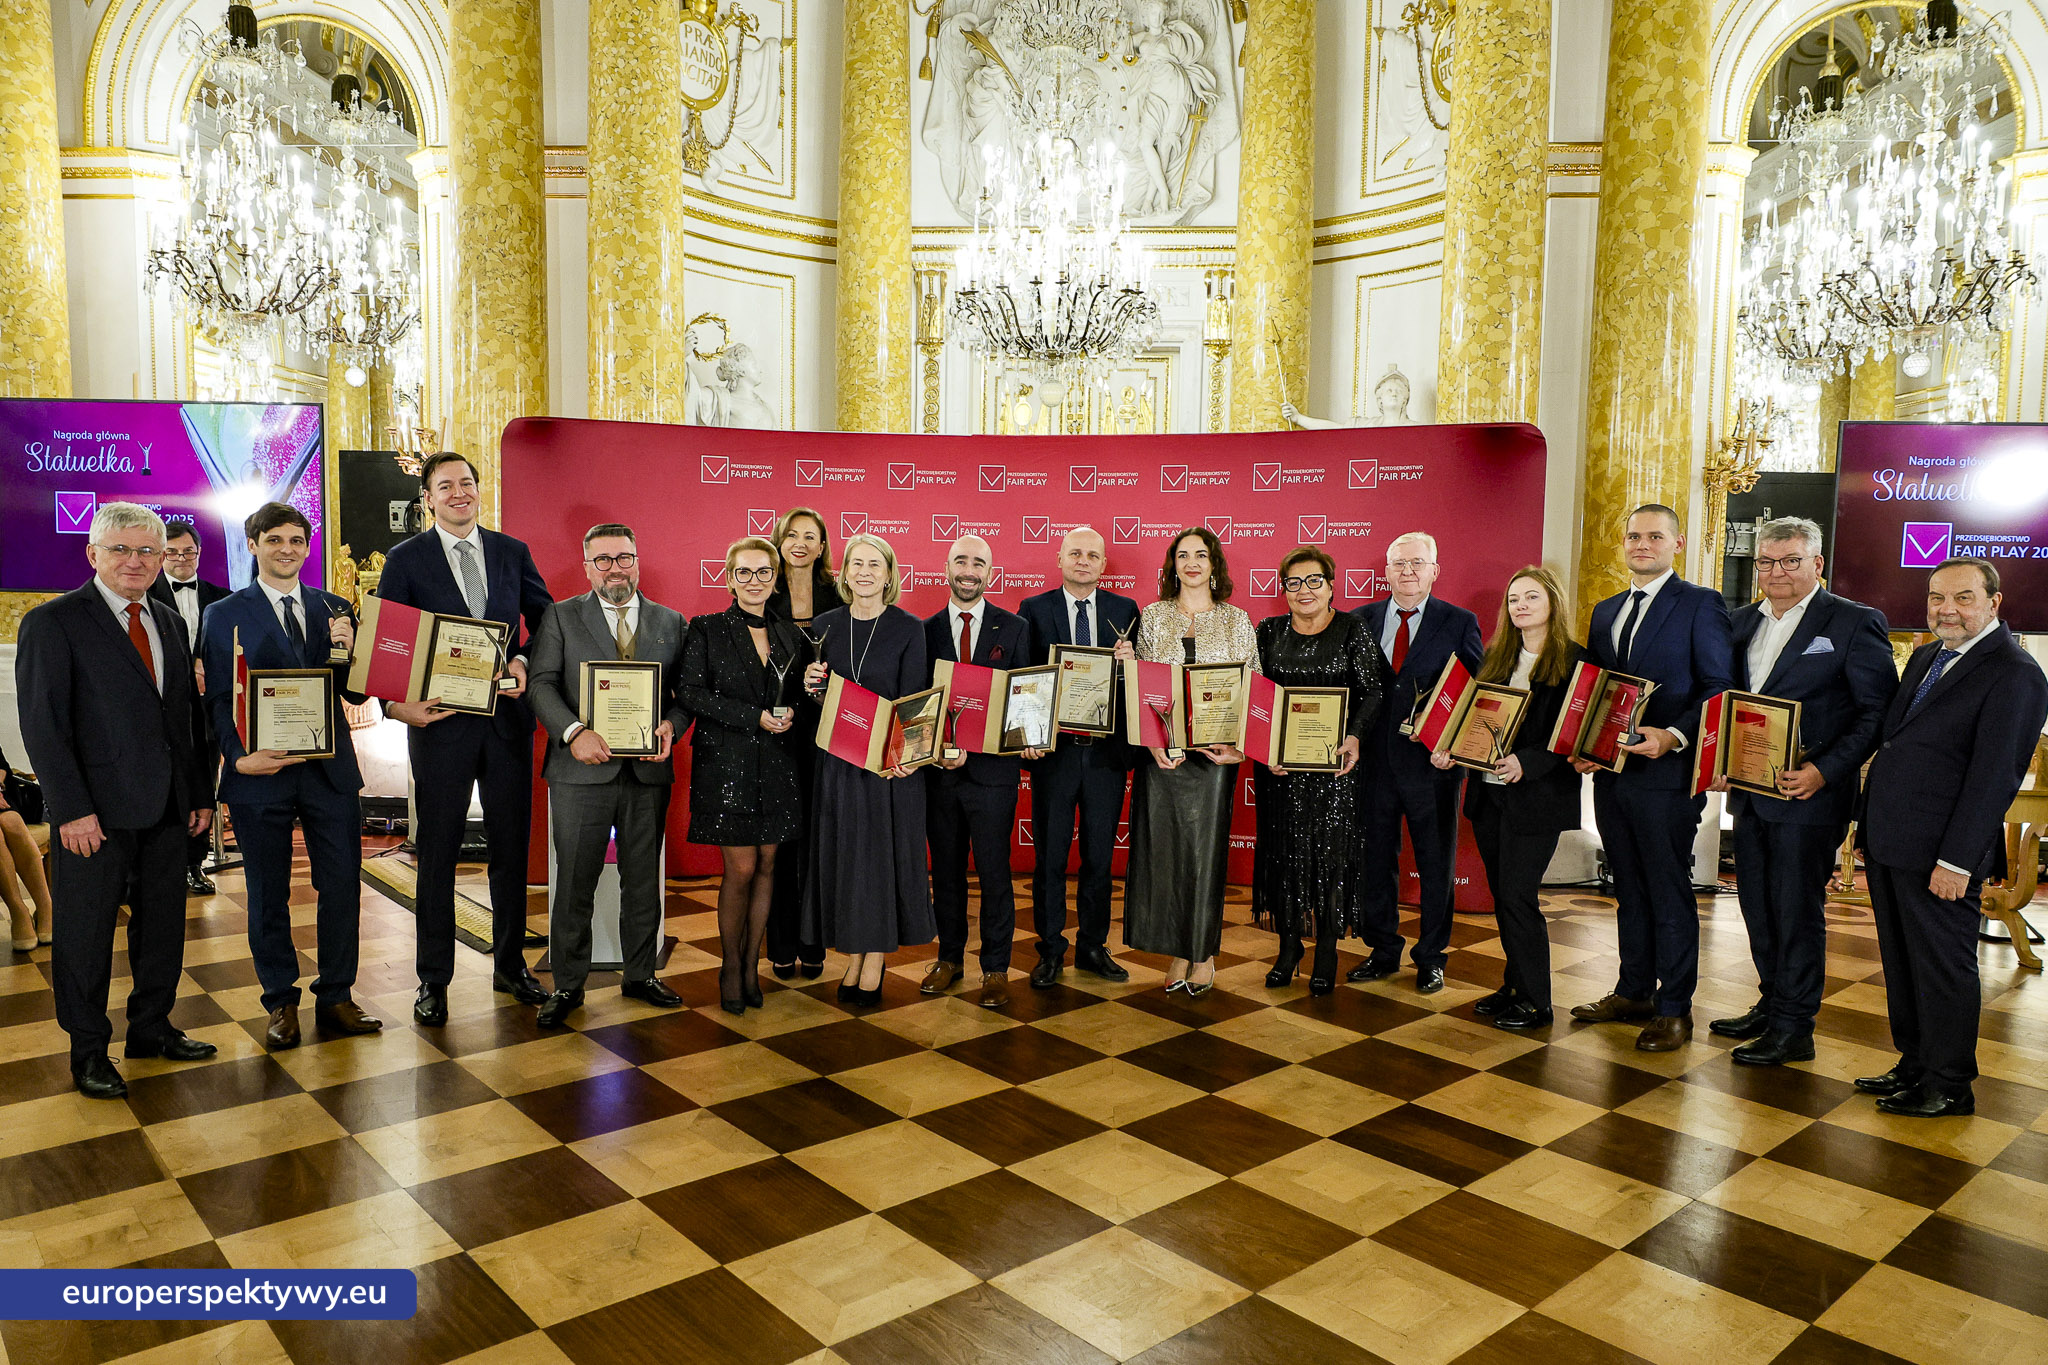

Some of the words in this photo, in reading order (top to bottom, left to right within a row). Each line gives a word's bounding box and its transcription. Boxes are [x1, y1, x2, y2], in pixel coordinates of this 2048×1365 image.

[680, 42, 722, 72] IANDO
[53, 431, 93, 442] Nagroda
[95, 431, 130, 442] główna
[24, 442, 135, 473] Statuetka
[1908, 456, 1956, 468] Nagroda
[731, 470, 749, 478] FAIR
[751, 471, 773, 479] PLAY
[845, 474, 865, 482] PLAY
[1379, 473, 1399, 481] FAIR
[1400, 472, 1423, 480] PLAY
[1303, 475, 1325, 483] PLAY
[889, 526, 910, 534] PLAY
[980, 528, 1000, 536] PLAY
[1328, 529, 1347, 537] FAIR
[1955, 535, 2031, 543] PRZEDSIĘBIORSTWO
[1953, 545, 1987, 557] FAIR
[1991, 546, 2029, 558] PLAY
[934, 578, 950, 586] PLA
[1024, 580, 1045, 588] PLAY
[1115, 581, 1135, 589] PLAY
[1229, 841, 1245, 849] AIR
[1246, 842, 1256, 850] PL
